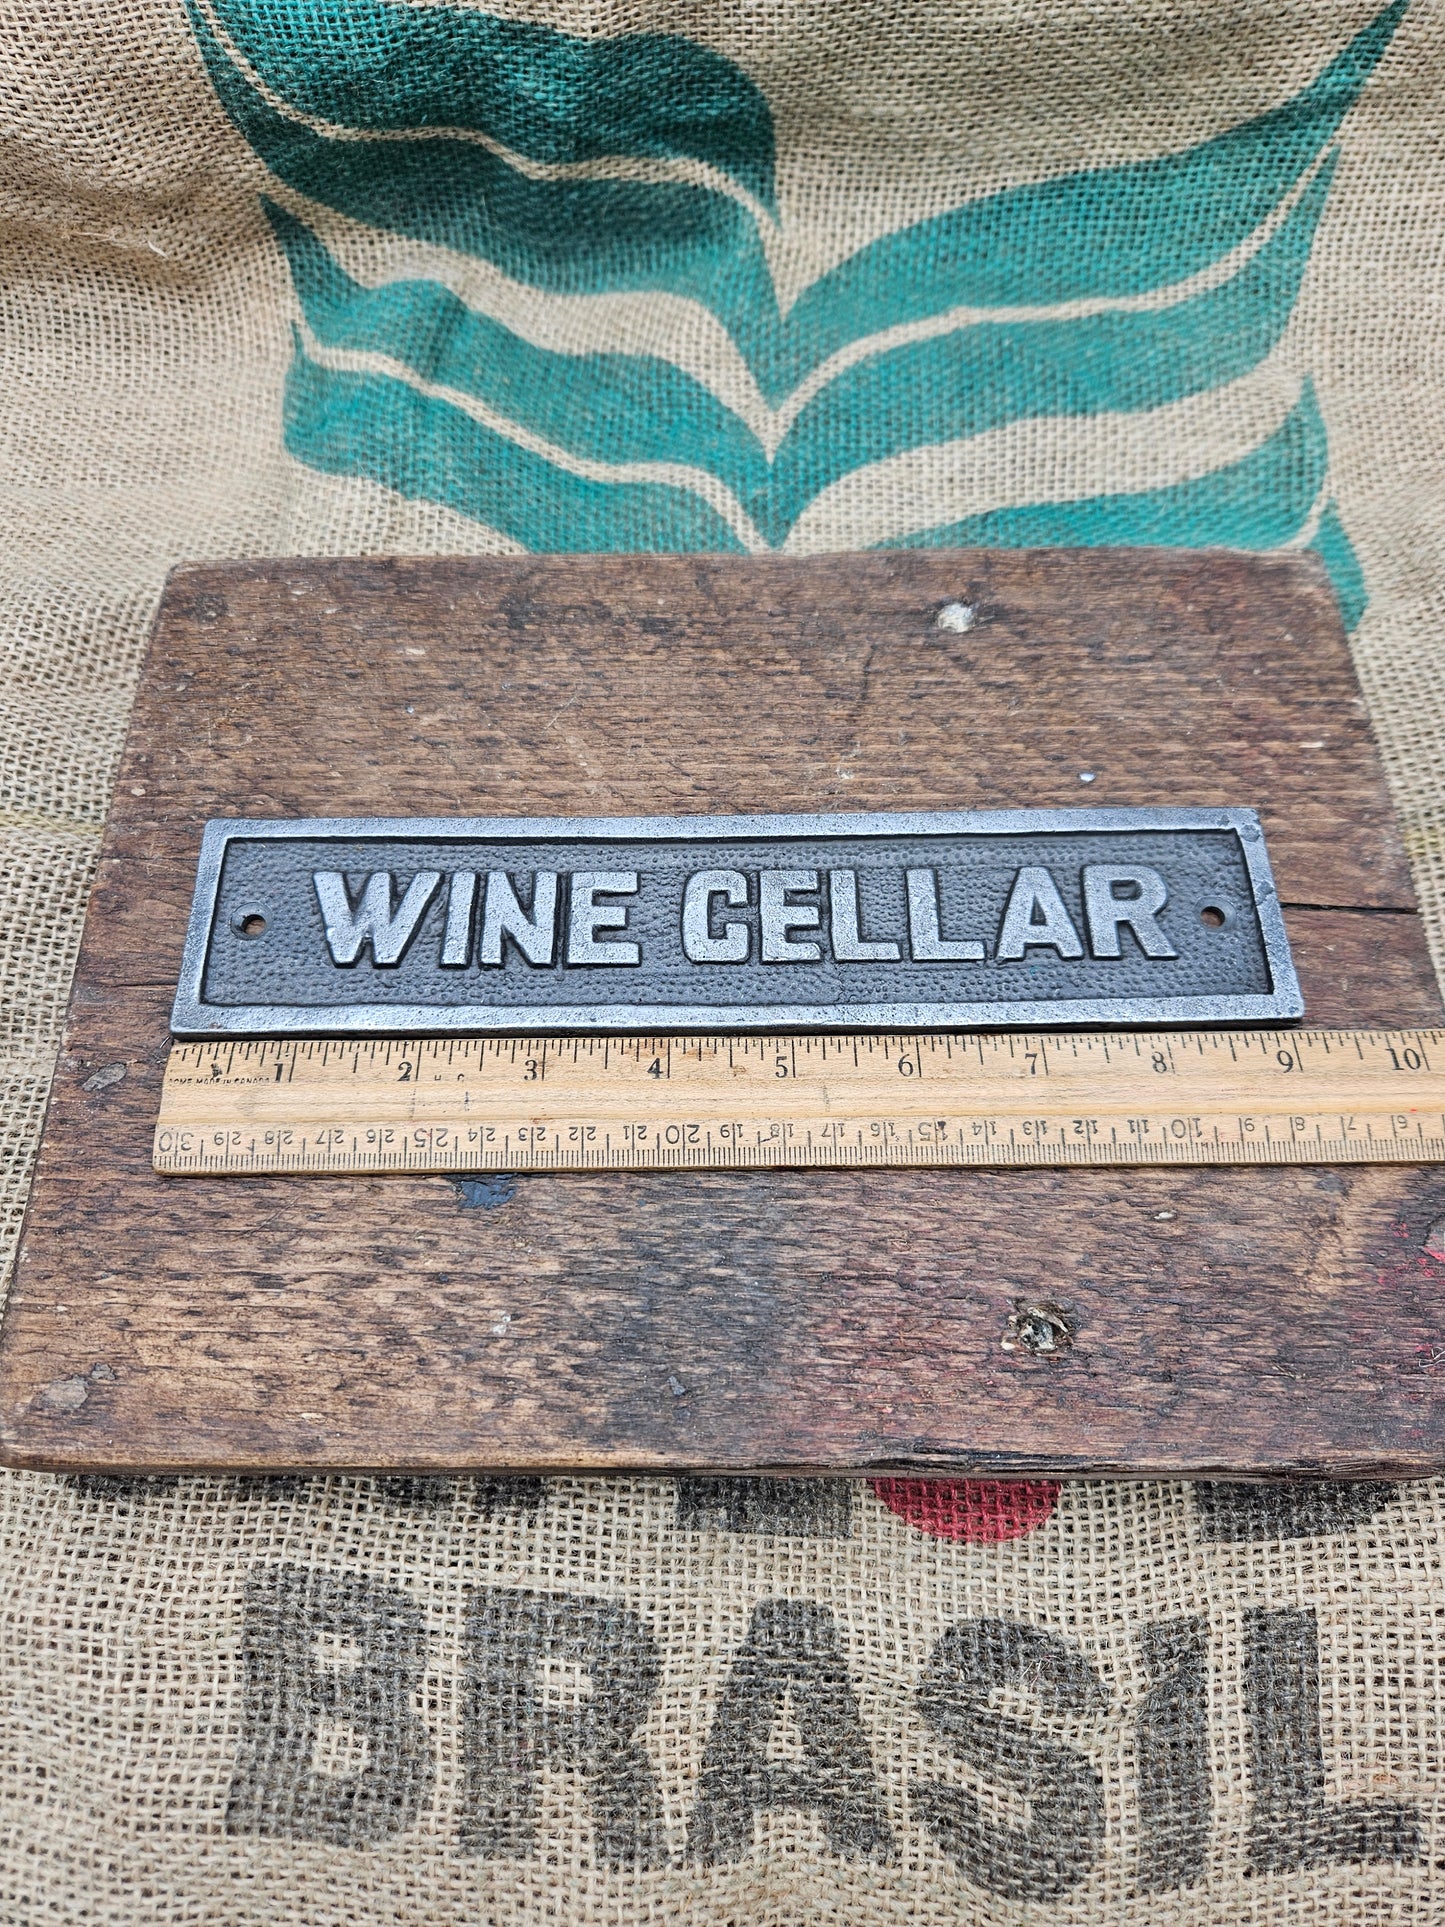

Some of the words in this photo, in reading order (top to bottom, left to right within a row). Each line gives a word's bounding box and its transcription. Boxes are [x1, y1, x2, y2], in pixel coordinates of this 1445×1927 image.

[312, 867, 641, 969] WINE
[681, 863, 1178, 965] CELLAR
[273, 1063, 284, 1082] 1
[397, 1062, 412, 1081] 2
[523, 1059, 538, 1081] 3
[647, 1057, 663, 1079] 4
[775, 1056, 788, 1078] 5
[898, 1053, 914, 1077] 6
[1024, 1053, 1038, 1075] 7
[1152, 1051, 1167, 1073] 8
[1277, 1050, 1294, 1073] 9
[1385, 1047, 1421, 1071] 10
[870, 1122, 896, 1137] 16
[971, 1120, 997, 1136] 14
[1022, 1120, 1048, 1135] 13
[1073, 1119, 1098, 1135] 12
[1127, 1119, 1149, 1134] 11
[1171, 1117, 1203, 1139] 10
[1244, 1117, 1255, 1132] 9
[1294, 1116, 1306, 1131] 8
[1346, 1116, 1357, 1131] 7
[1398, 1115, 1408, 1129] 6
[264, 1130, 293, 1145] 28
[315, 1129, 344, 1145] 27
[366, 1129, 395, 1144] 26
[468, 1127, 496, 1143] 24
[518, 1126, 546, 1142] 23
[569, 1126, 597, 1141] 22
[623, 1125, 648, 1140] 21
[665, 1124, 701, 1145] 20
[720, 1123, 744, 1138] 19
[821, 1122, 845, 1138] 17
[158, 1131, 194, 1152] 30
[213, 1131, 241, 1145] 29
[413, 1128, 449, 1148] 25
[223, 1559, 1422, 1906] BRASIL
